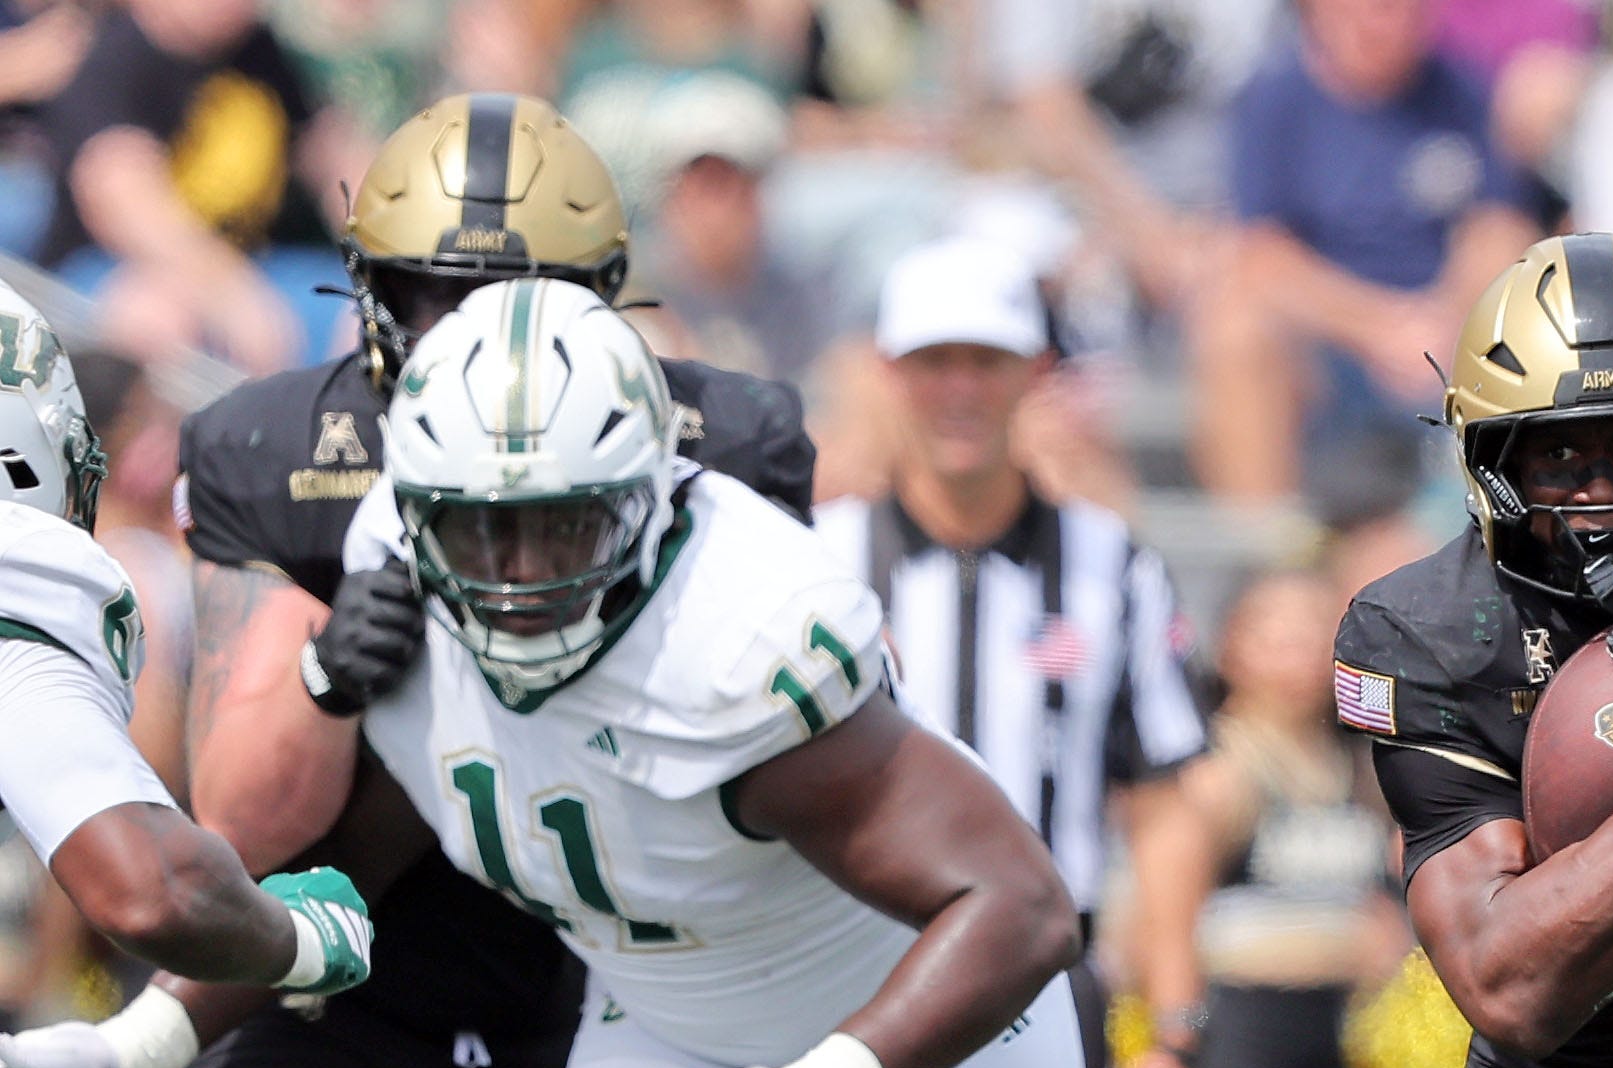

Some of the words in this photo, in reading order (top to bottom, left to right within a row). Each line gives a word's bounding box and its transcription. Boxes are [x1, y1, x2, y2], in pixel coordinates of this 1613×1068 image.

[455, 229, 507, 252] ARMY
[763, 612, 867, 738] 11
[442, 747, 703, 953] 11
